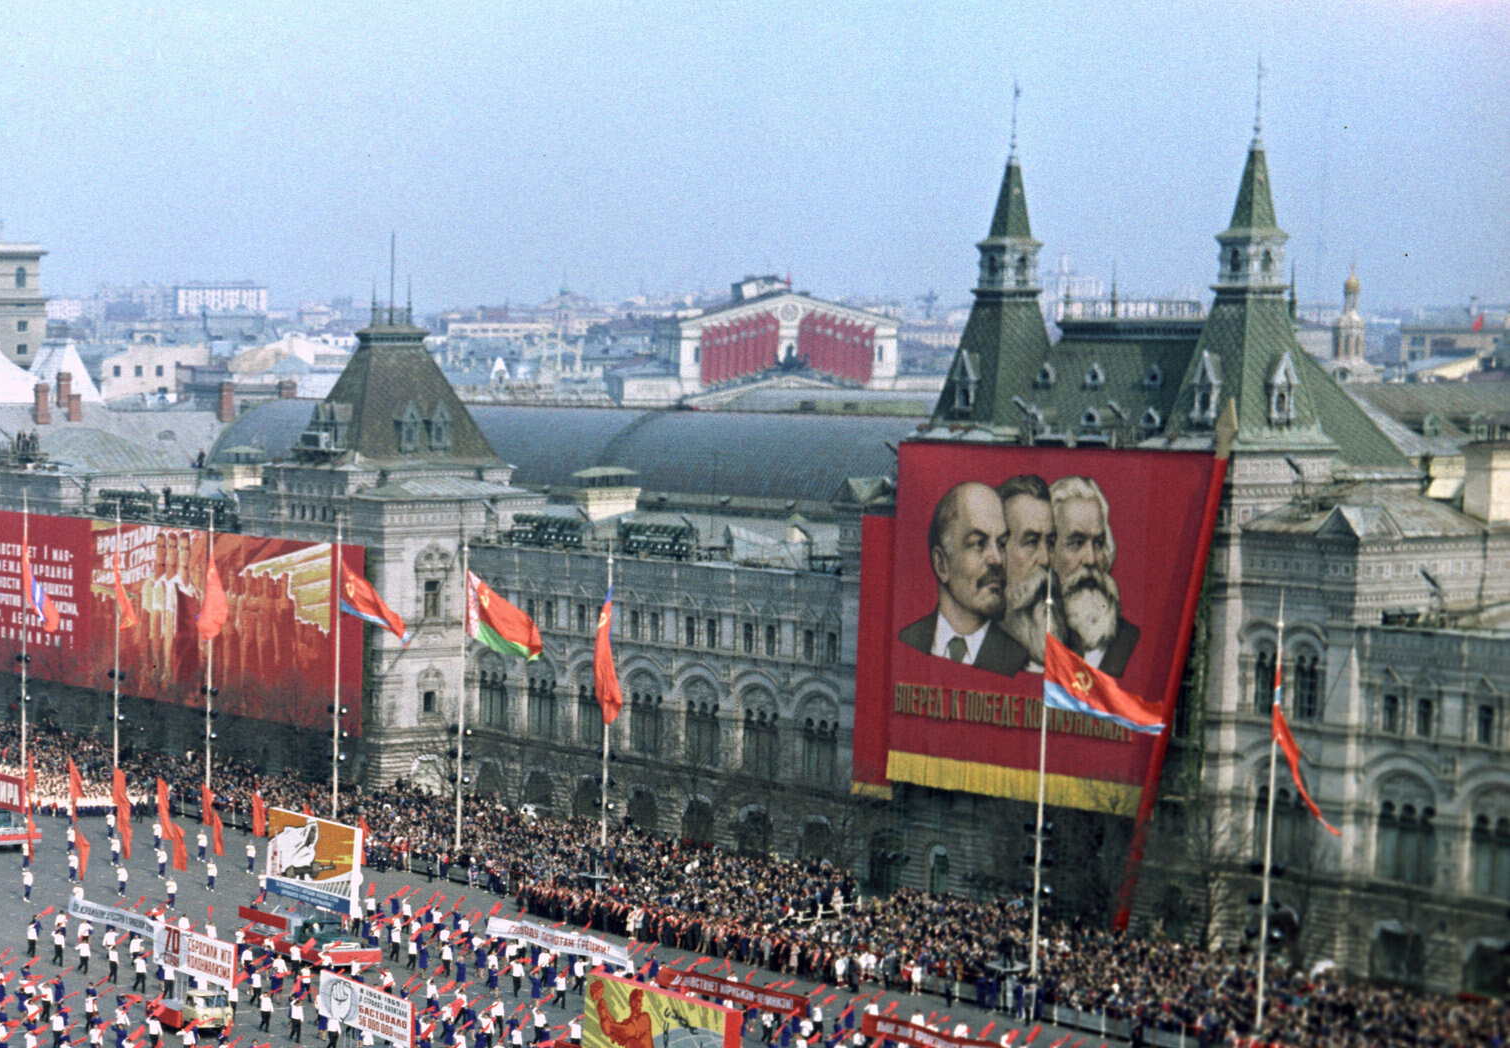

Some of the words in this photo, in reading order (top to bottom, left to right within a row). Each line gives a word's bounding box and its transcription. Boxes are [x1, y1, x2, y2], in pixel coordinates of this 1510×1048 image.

[951, 689, 962, 720] К
[965, 691, 1018, 728] ПОБЕДЕ
[165, 926, 181, 955] 70
[188, 938, 218, 961] СБРОСИЛИ
[221, 949, 232, 965] ИГО
[187, 954, 231, 979] КОЛОНИАЛИЗМА
[358, 1004, 407, 1029] БАСТОВАЛО
